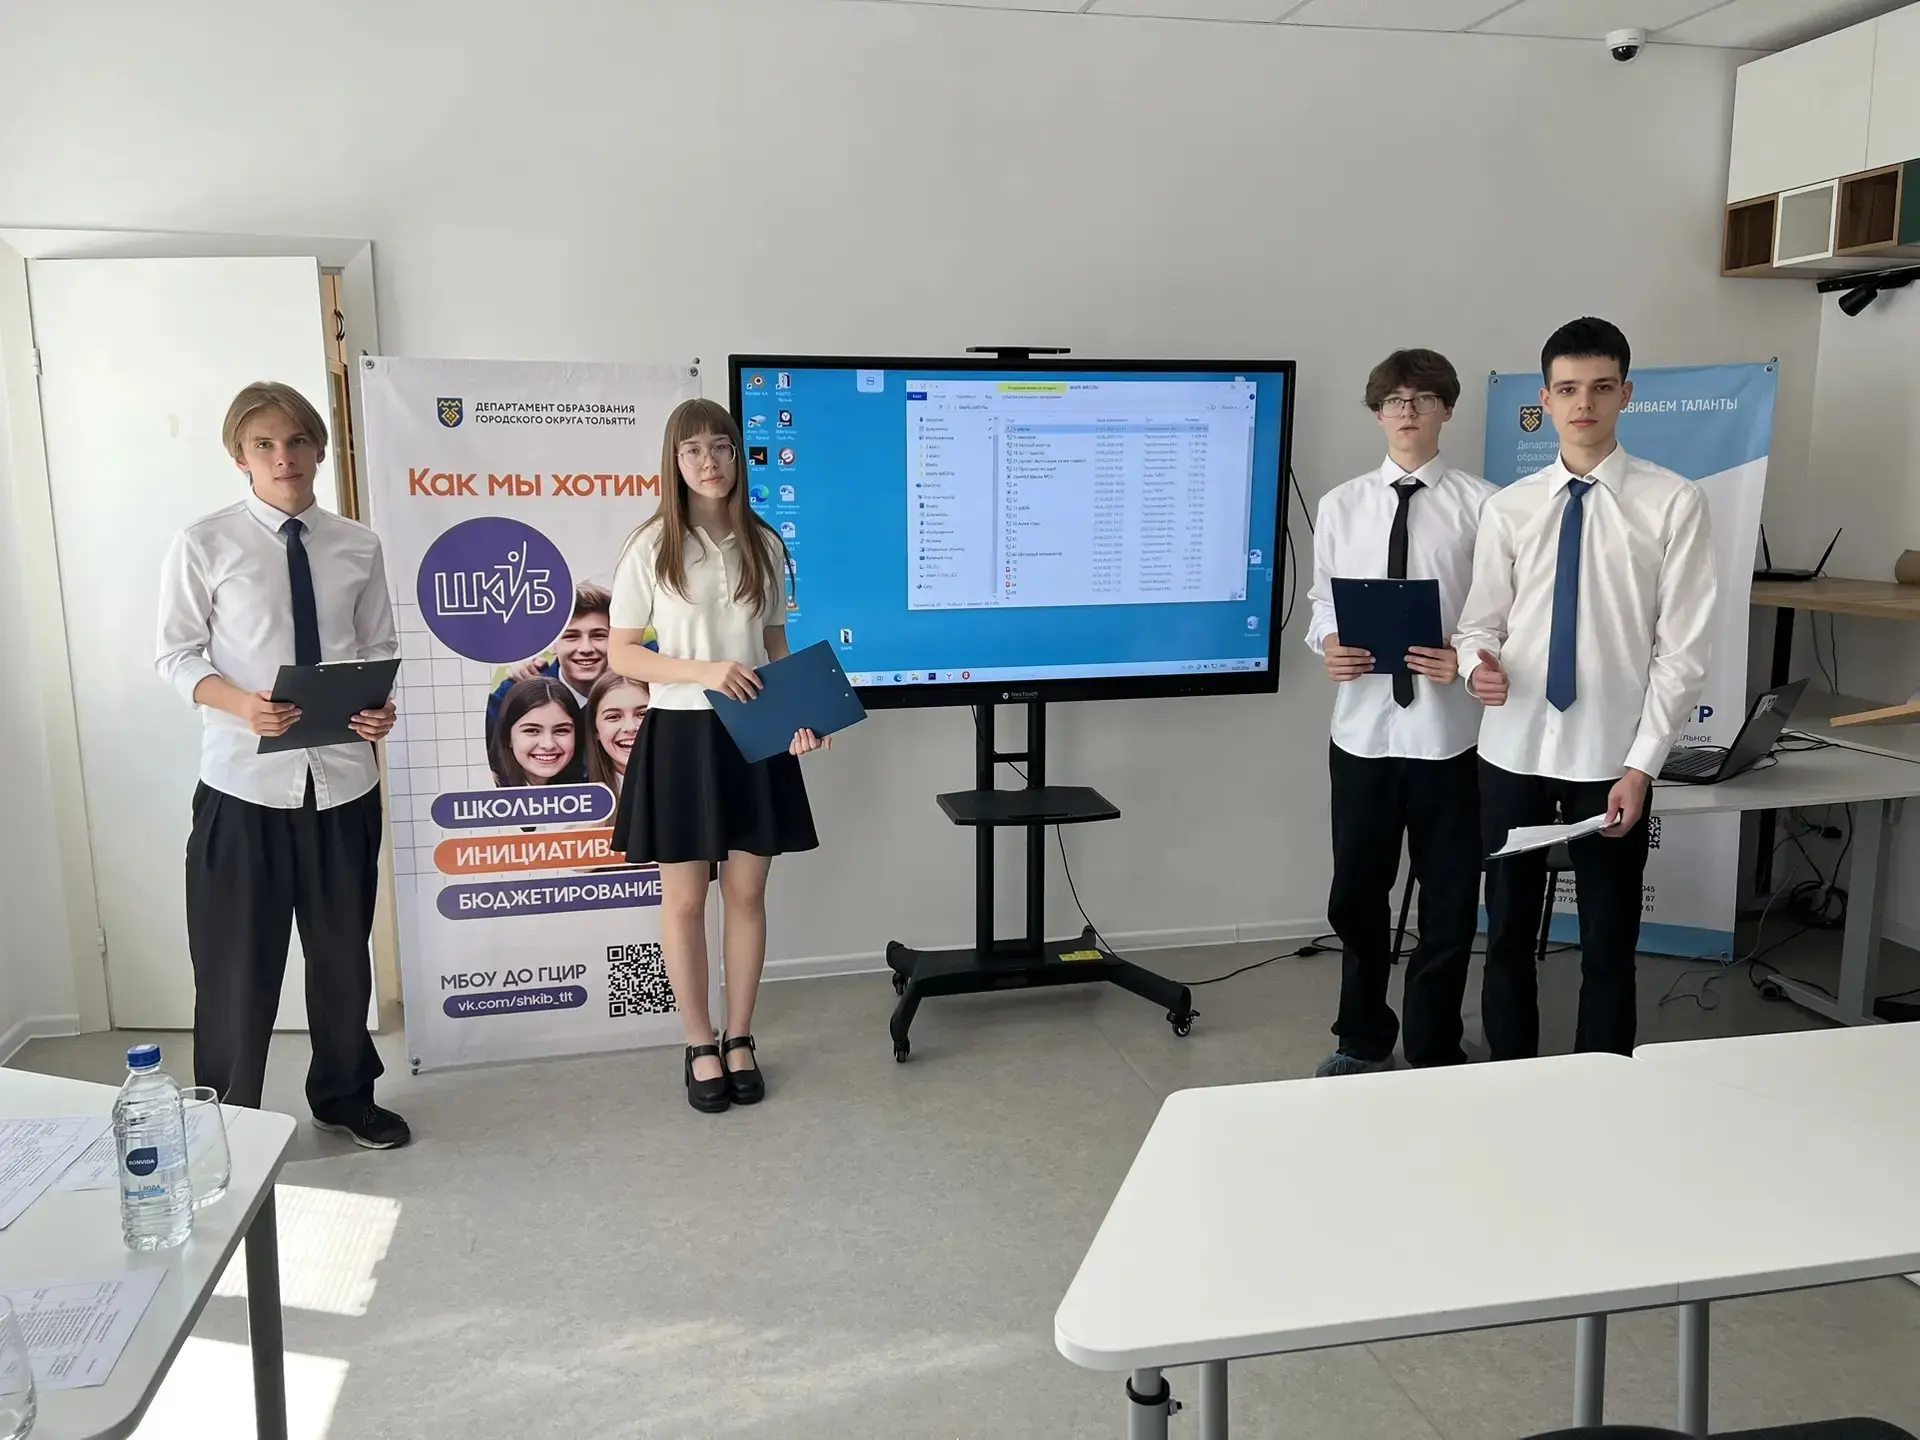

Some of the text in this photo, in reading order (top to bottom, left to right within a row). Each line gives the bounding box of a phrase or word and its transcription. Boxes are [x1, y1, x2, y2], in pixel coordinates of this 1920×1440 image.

[475, 402, 635, 413] ДЕПАРТАМЕНТ ОБРАЗОВАНИЯ
[1681, 398, 1738, 411] ТАЛАНТЫ
[475, 415, 636, 425] ГОРОДСКОГО ОКРУГА ТОЛЬЯТТИ
[408, 468, 661, 497] Как мы хотим
[453, 794, 592, 820] ШКОЛЬНОЕ
[459, 880, 662, 910] БЮДЖЕТИРОВАНИЕ
[441, 964, 587, 990] МБОУ ДО ГЦИР
[458, 991, 573, 1012] vk.com/shkib_tlt
